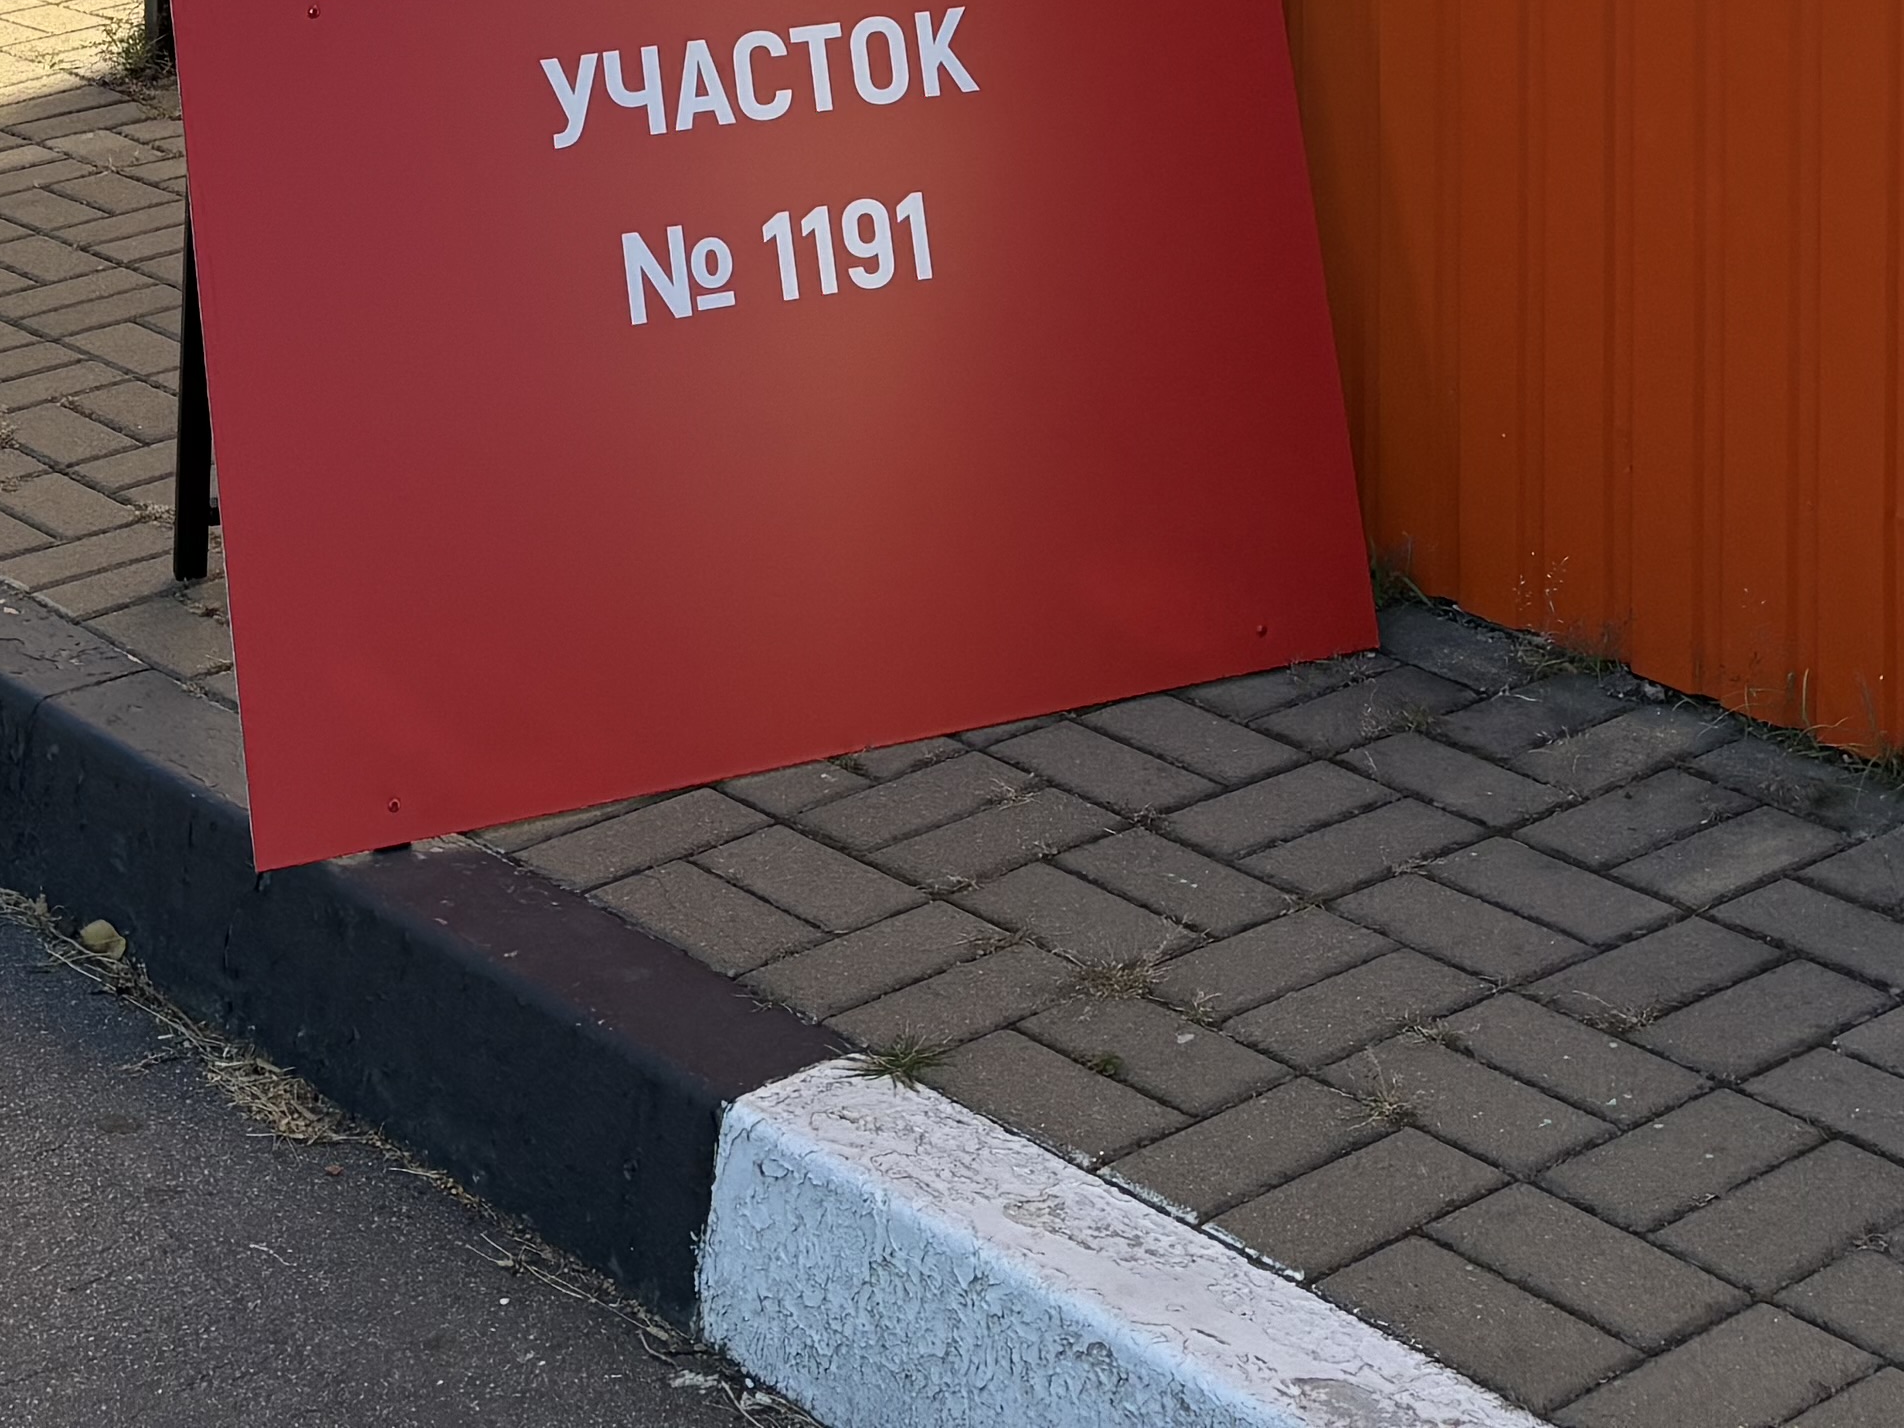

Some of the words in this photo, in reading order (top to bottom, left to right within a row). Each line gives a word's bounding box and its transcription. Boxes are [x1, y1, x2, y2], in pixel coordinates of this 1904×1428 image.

[538, 5, 981, 151] УЧАСТОК
[620, 223, 737, 327] №
[760, 190, 934, 302] 1191
